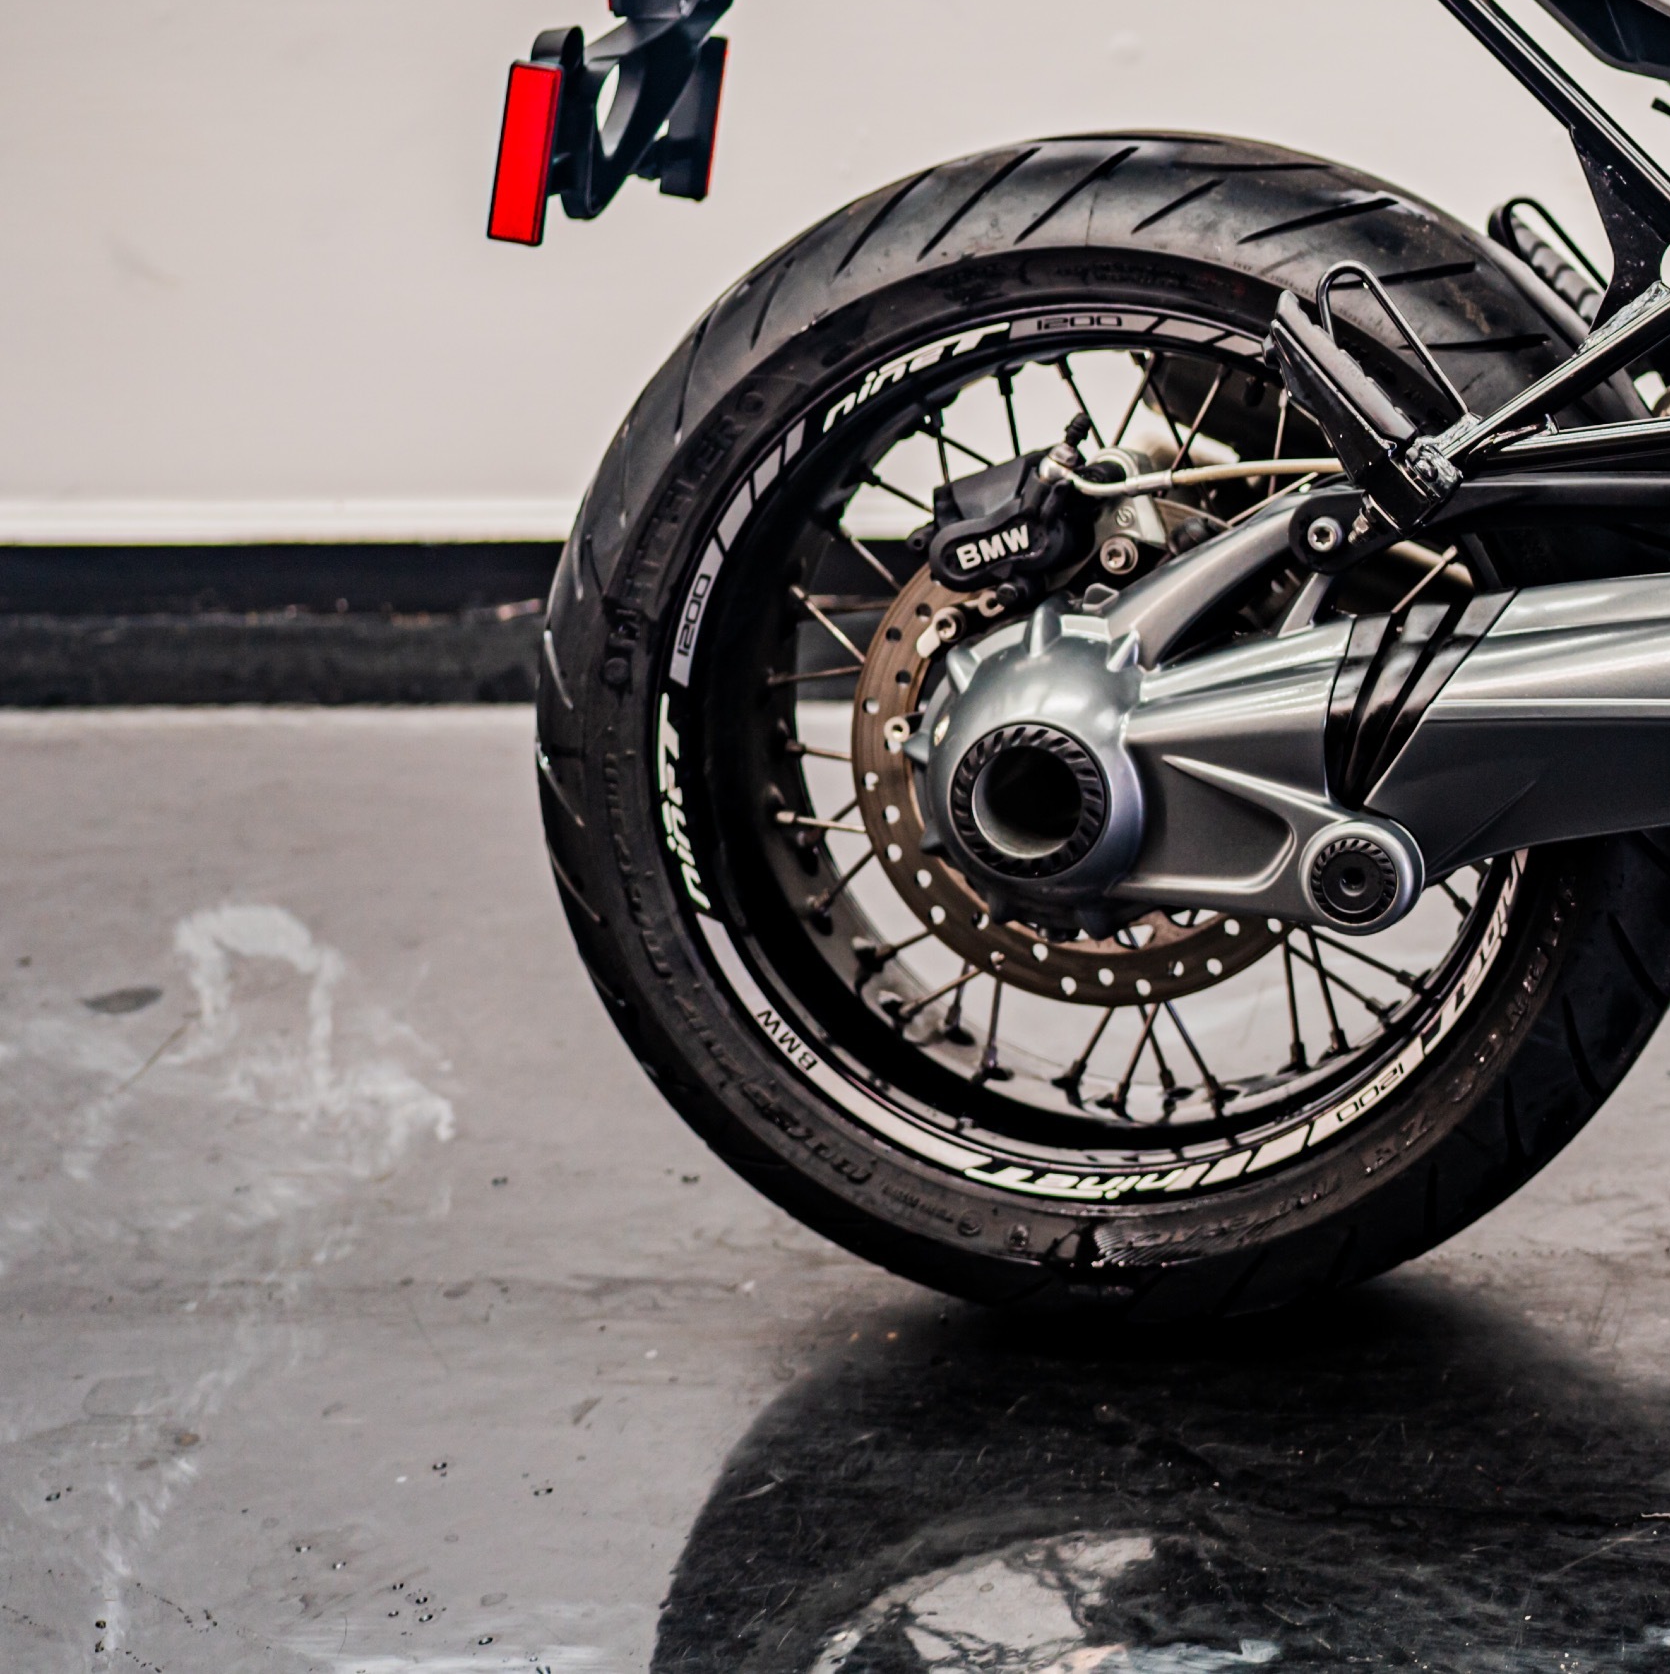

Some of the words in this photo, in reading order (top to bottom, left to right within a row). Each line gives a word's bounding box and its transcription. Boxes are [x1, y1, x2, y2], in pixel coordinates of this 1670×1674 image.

[1037, 315, 1122, 331] 1200
[823, 322, 1010, 433] nineT
[956, 524, 1029, 570] BMW
[677, 575, 710, 657] 1200
[757, 1009, 818, 1073] BMW
[1336, 1062, 1404, 1122] 1200
